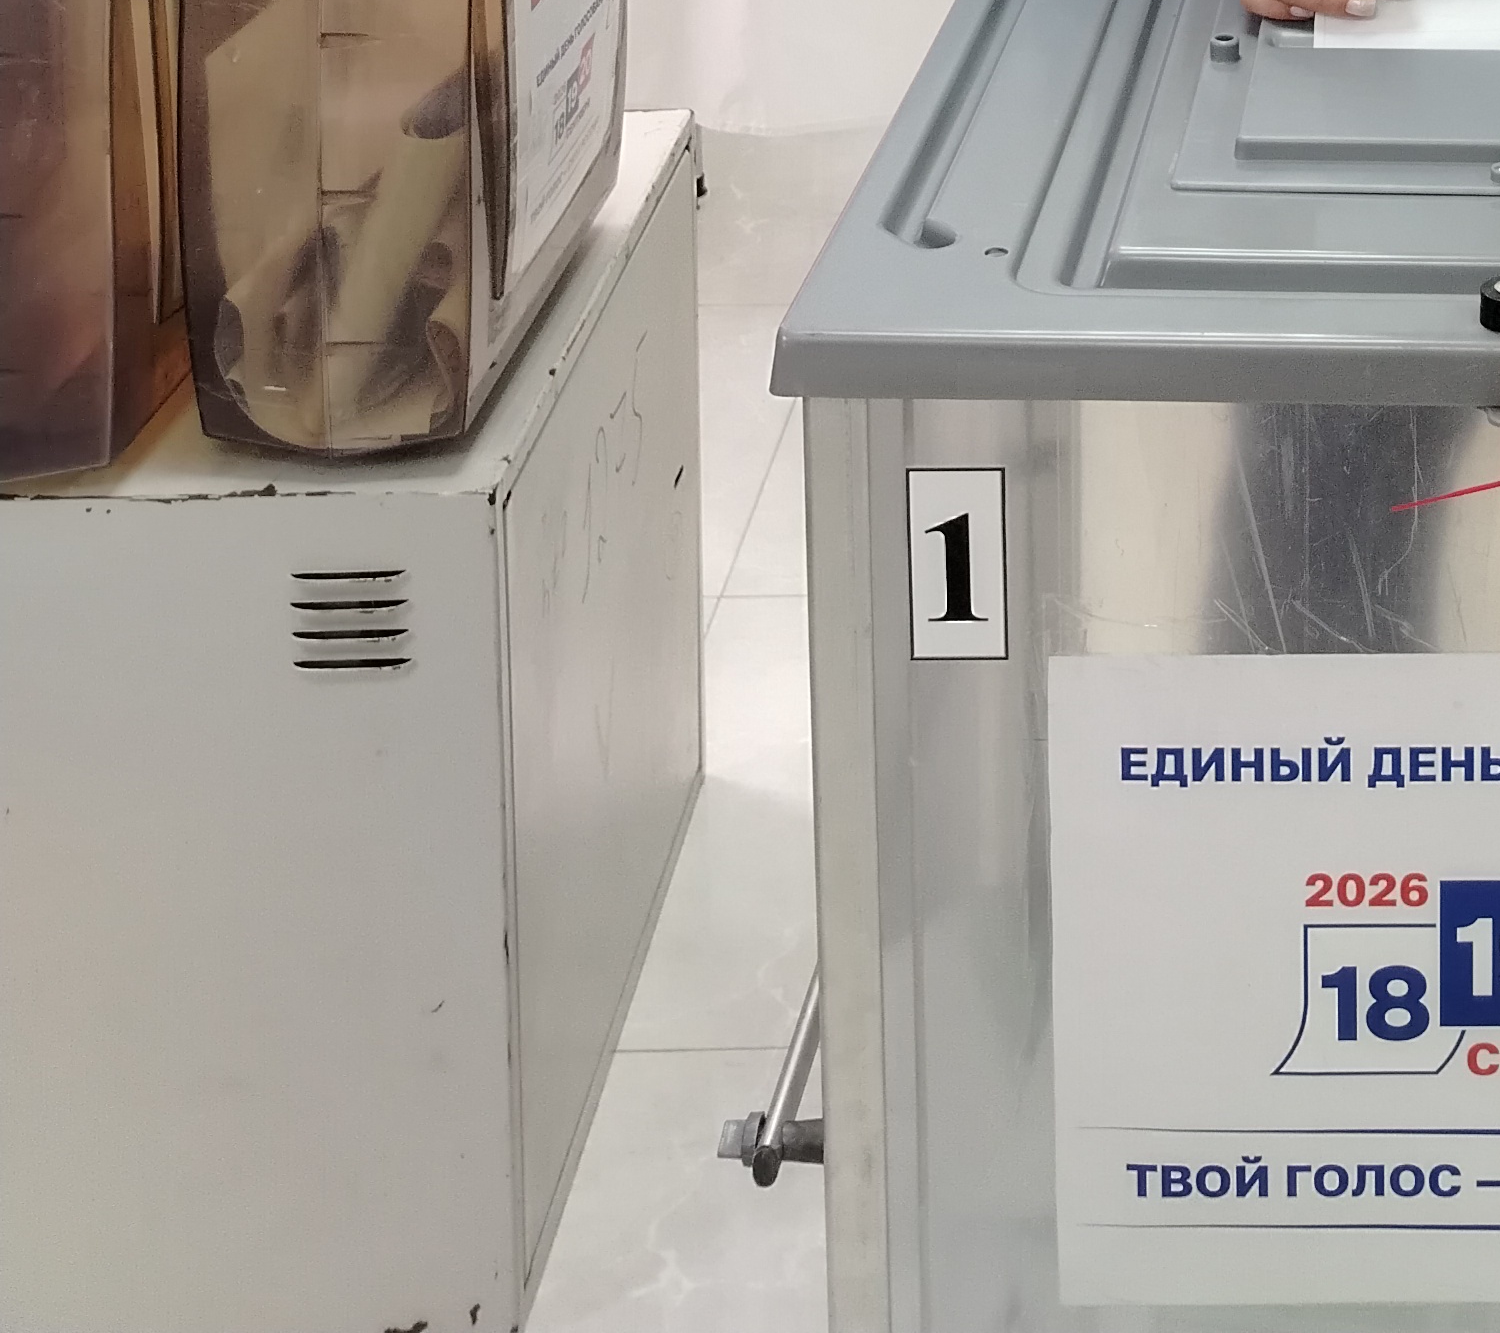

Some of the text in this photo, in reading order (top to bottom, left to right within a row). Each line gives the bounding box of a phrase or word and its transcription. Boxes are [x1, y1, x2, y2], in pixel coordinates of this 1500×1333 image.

[536, 47, 561, 88] ЕДИНЫЙ
[560, 34, 575, 61] ДЕНЬ
[554, 48, 592, 146] 18 19 20
[924, 512, 989, 622] 1
[1121, 737, 1352, 789] ЕДИНЫЙ
[1306, 873, 1429, 909] 2026
[1322, 966, 1430, 1042] 18
[1127, 1156, 1270, 1199] ТВОЙ
[1287, 1164, 1463, 1199] ГОЛОС
